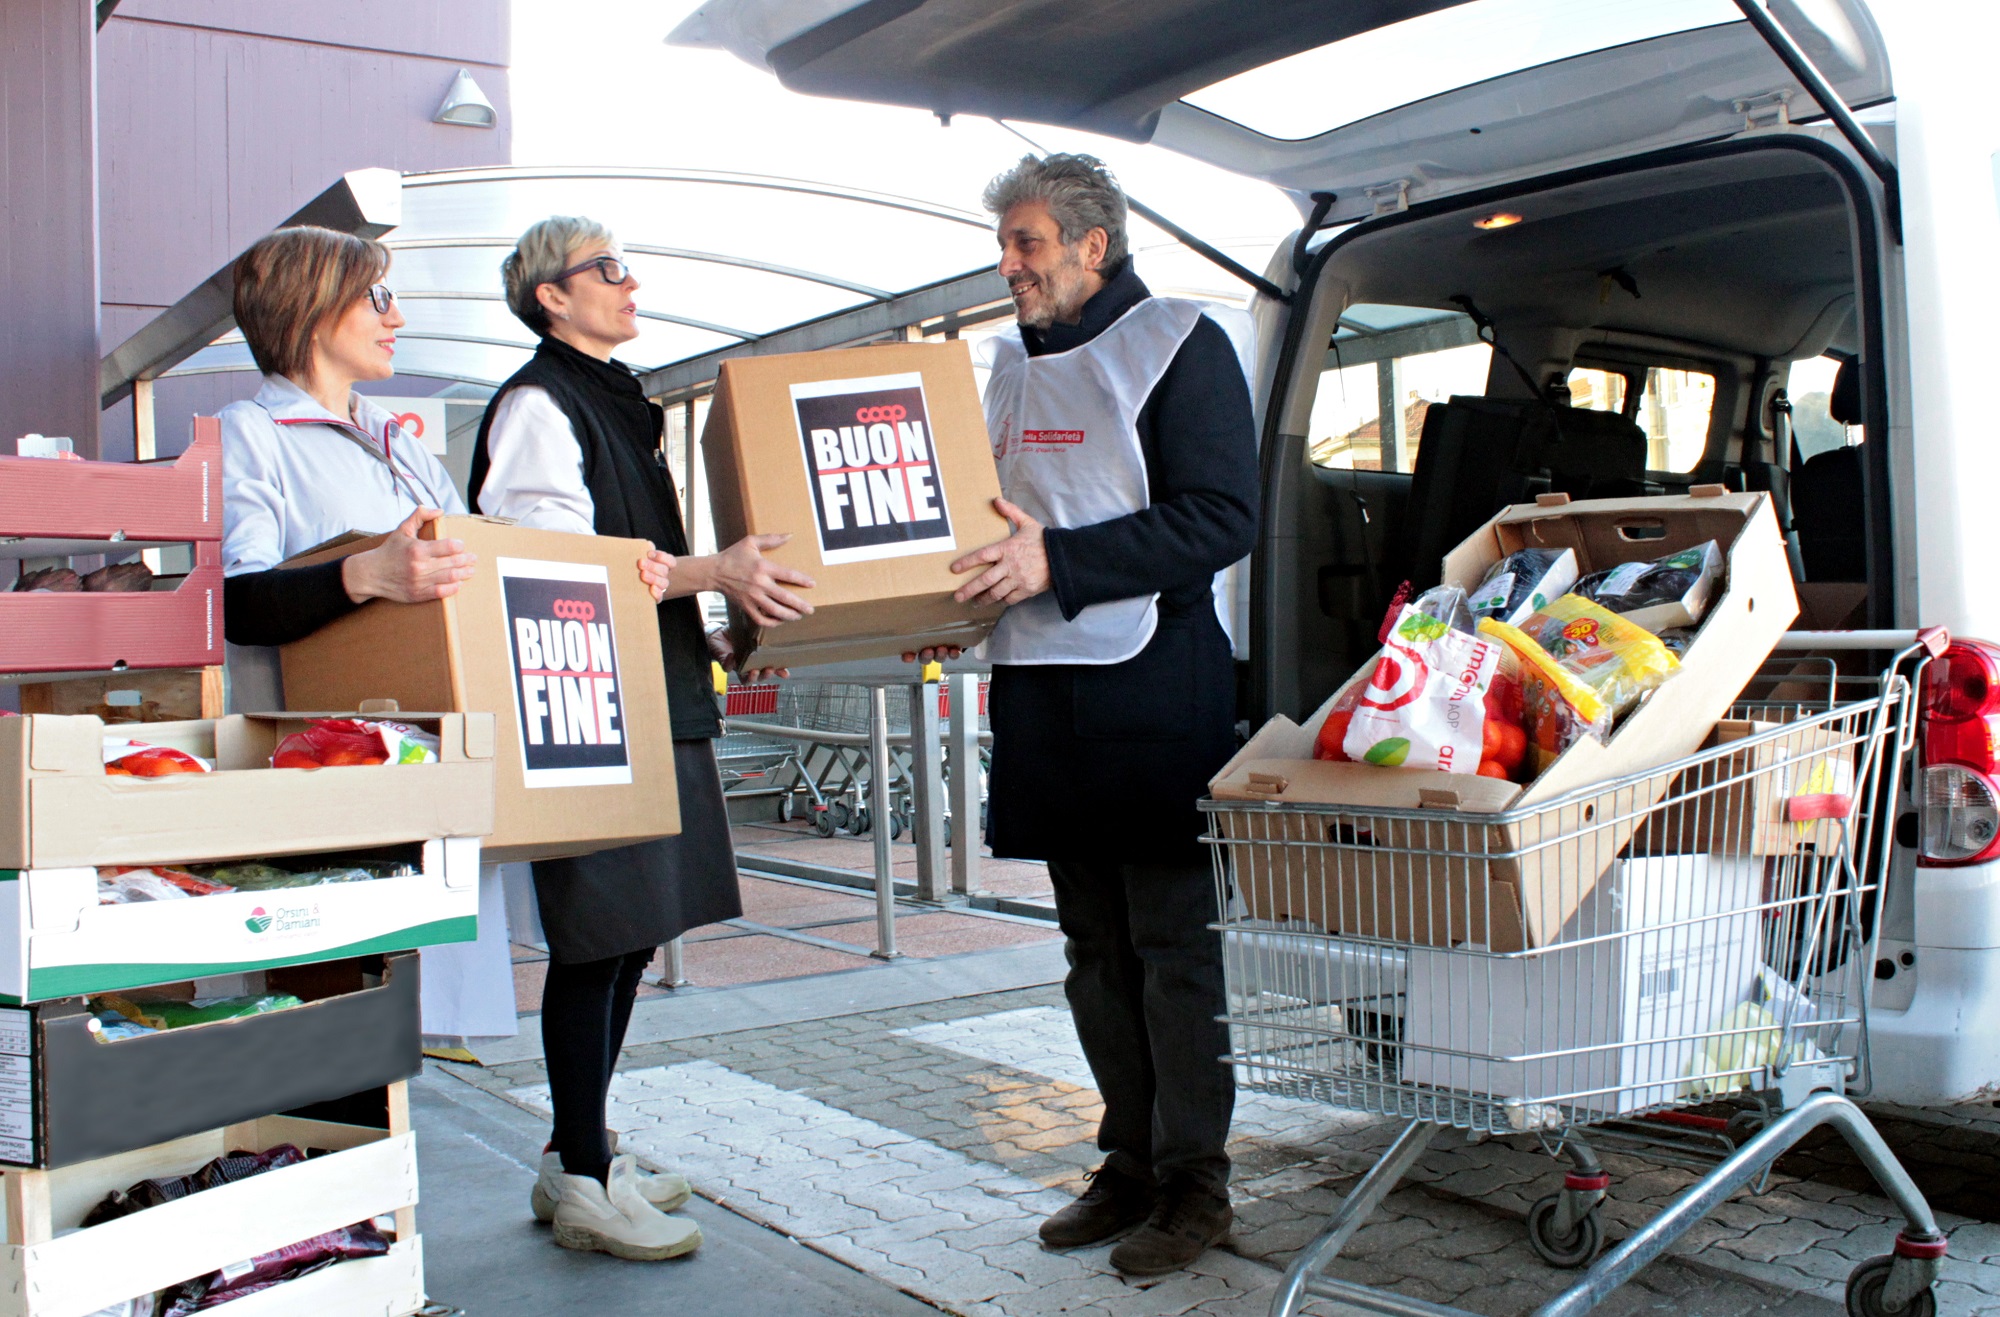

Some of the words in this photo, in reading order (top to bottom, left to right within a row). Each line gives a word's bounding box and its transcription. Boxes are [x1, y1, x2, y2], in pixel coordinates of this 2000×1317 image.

[856, 404, 907, 424] coop
[810, 420, 930, 472] BUON
[1039, 431, 1081, 442] Solidarietà
[201, 461, 209, 522] www.ortoveneto.it
[818, 465, 942, 531] FINE
[205, 588, 213, 651] www.ortoveneto.it
[553, 598, 596, 621] coop
[1571, 623, 1592, 638] 30
[514, 617, 613, 673] BUON
[521, 674, 622, 745] FINE
[1446, 703, 1460, 729] AOP
[276, 907, 309, 919] Orsini
[312, 902, 320, 914] &
[276, 918, 320, 931] Damiani
